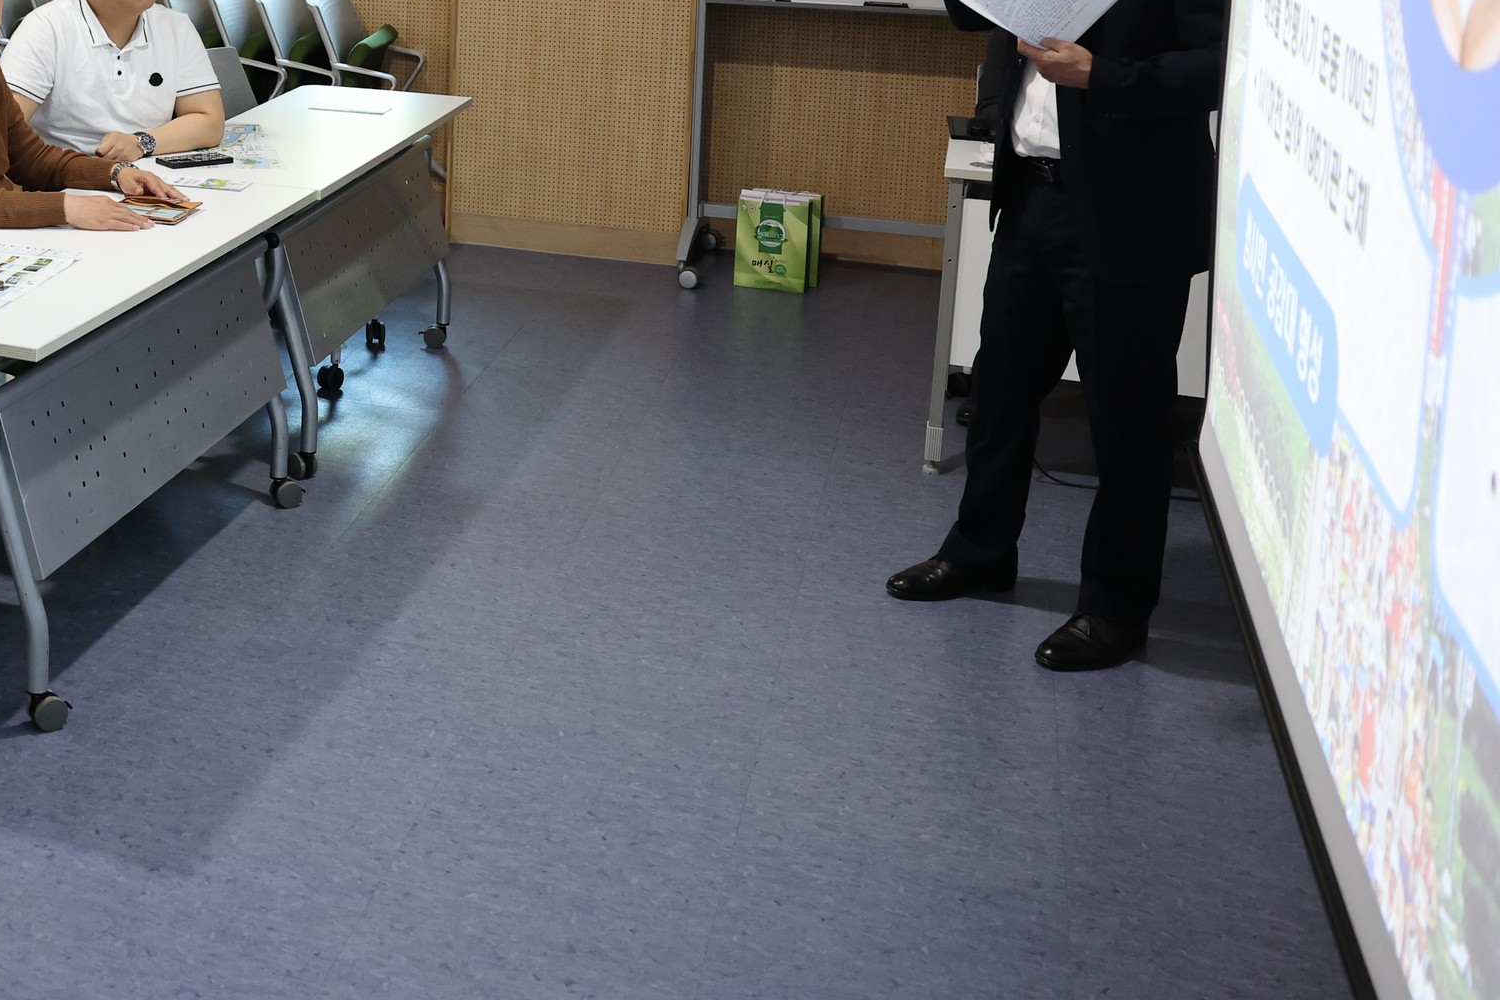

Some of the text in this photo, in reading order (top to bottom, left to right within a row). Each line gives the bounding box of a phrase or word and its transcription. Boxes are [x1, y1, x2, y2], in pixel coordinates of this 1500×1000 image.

[1319, 23, 1341, 95] 운동
[1285, 98, 1303, 163] 참여
[1266, 252, 1298, 358] 공감대
[1296, 304, 1324, 404] 형성
